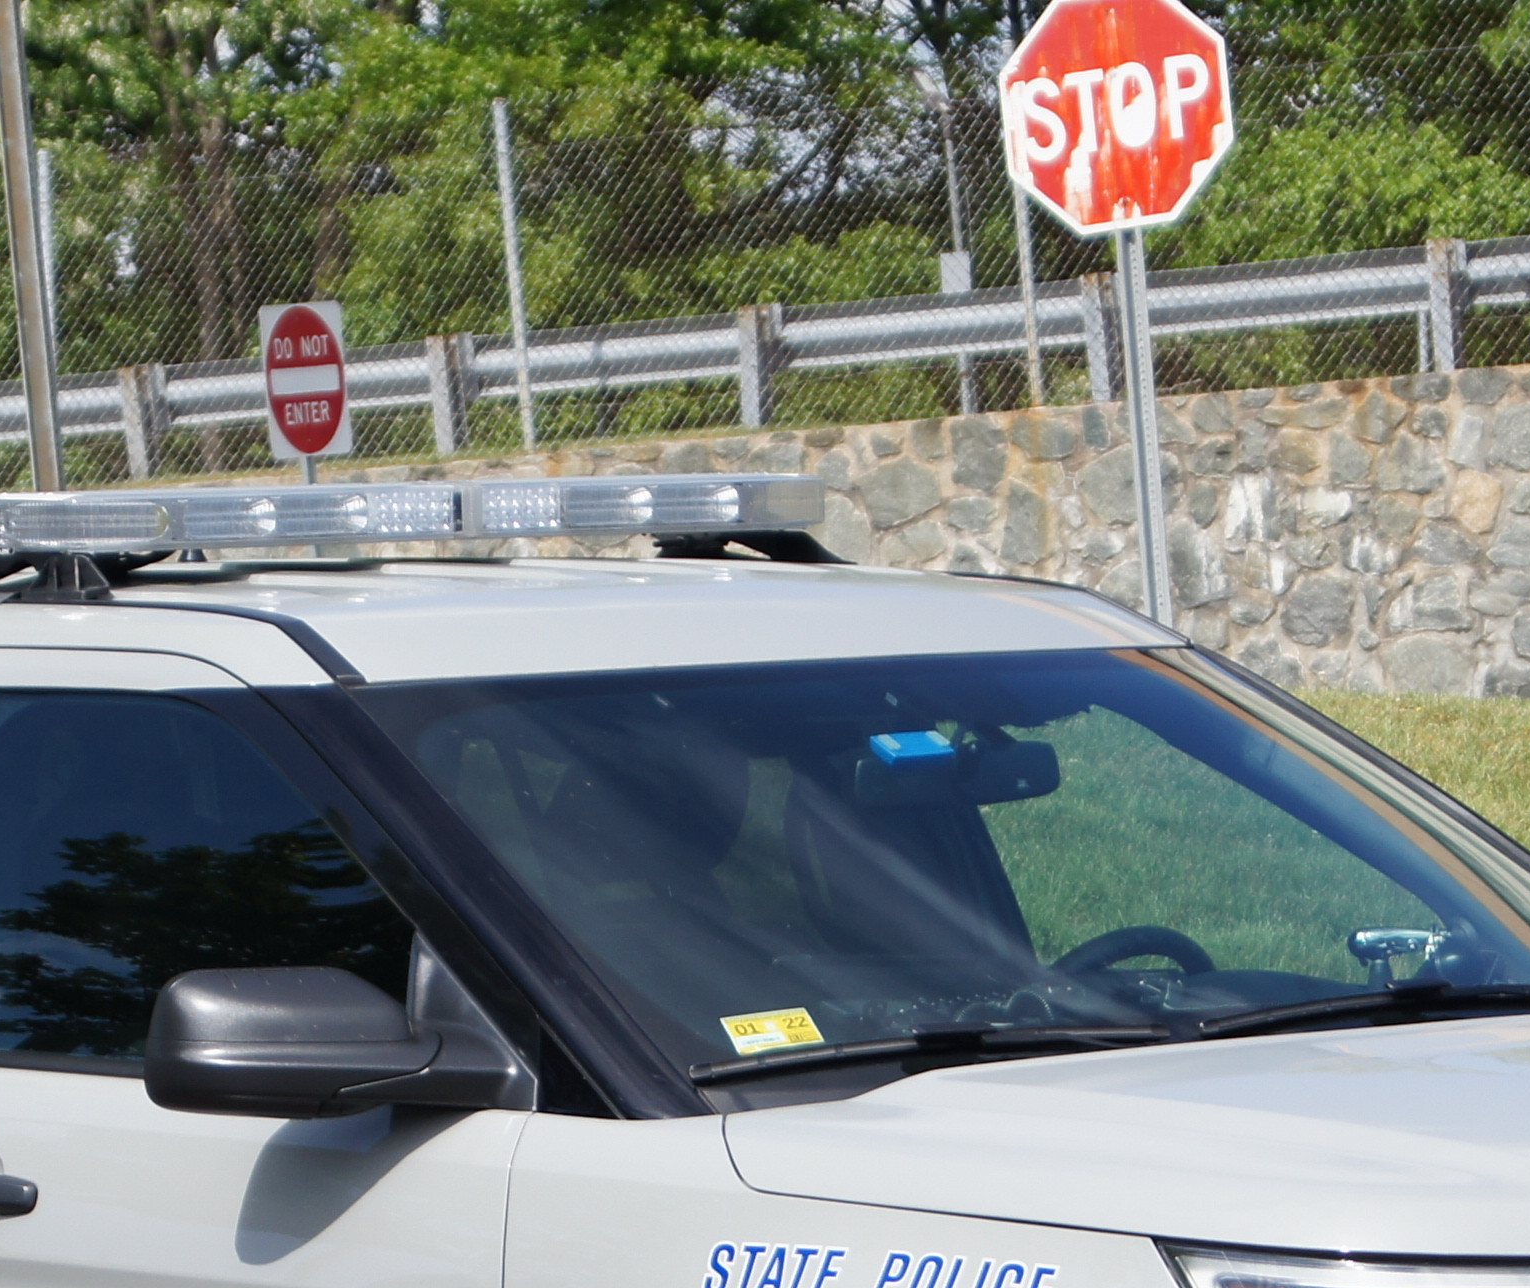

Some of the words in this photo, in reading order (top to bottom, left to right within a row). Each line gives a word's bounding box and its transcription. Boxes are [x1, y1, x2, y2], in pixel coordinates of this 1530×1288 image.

[1023, 53, 1209, 163] STOP
[273, 336, 292, 360] DO
[301, 334, 329, 358] NOT
[284, 400, 331, 425] ENTER
[734, 1021, 761, 1036] 01
[783, 1016, 809, 1029] 22
